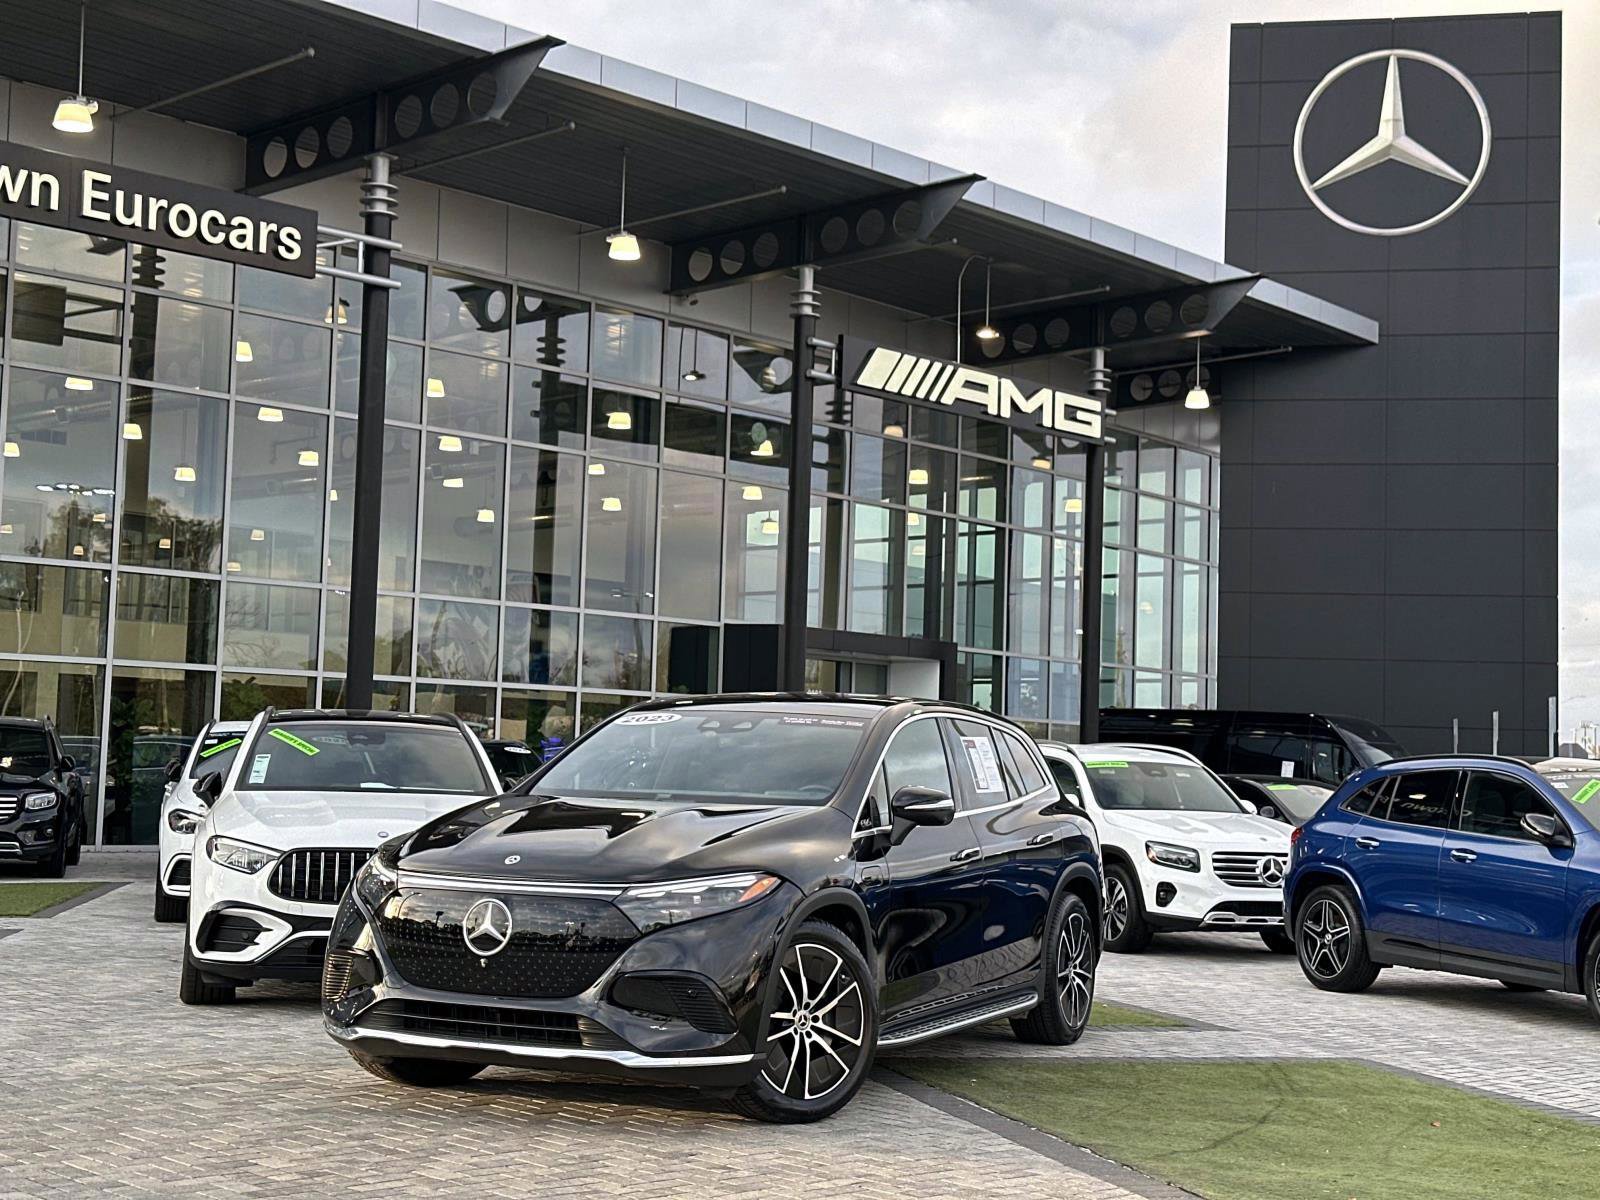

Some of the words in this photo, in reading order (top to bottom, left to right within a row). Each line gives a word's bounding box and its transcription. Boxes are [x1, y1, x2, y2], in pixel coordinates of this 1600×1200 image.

[81, 169, 302, 260] Eurocars
[940, 366, 1101, 439] AMG
[621, 714, 675, 723] 2023
